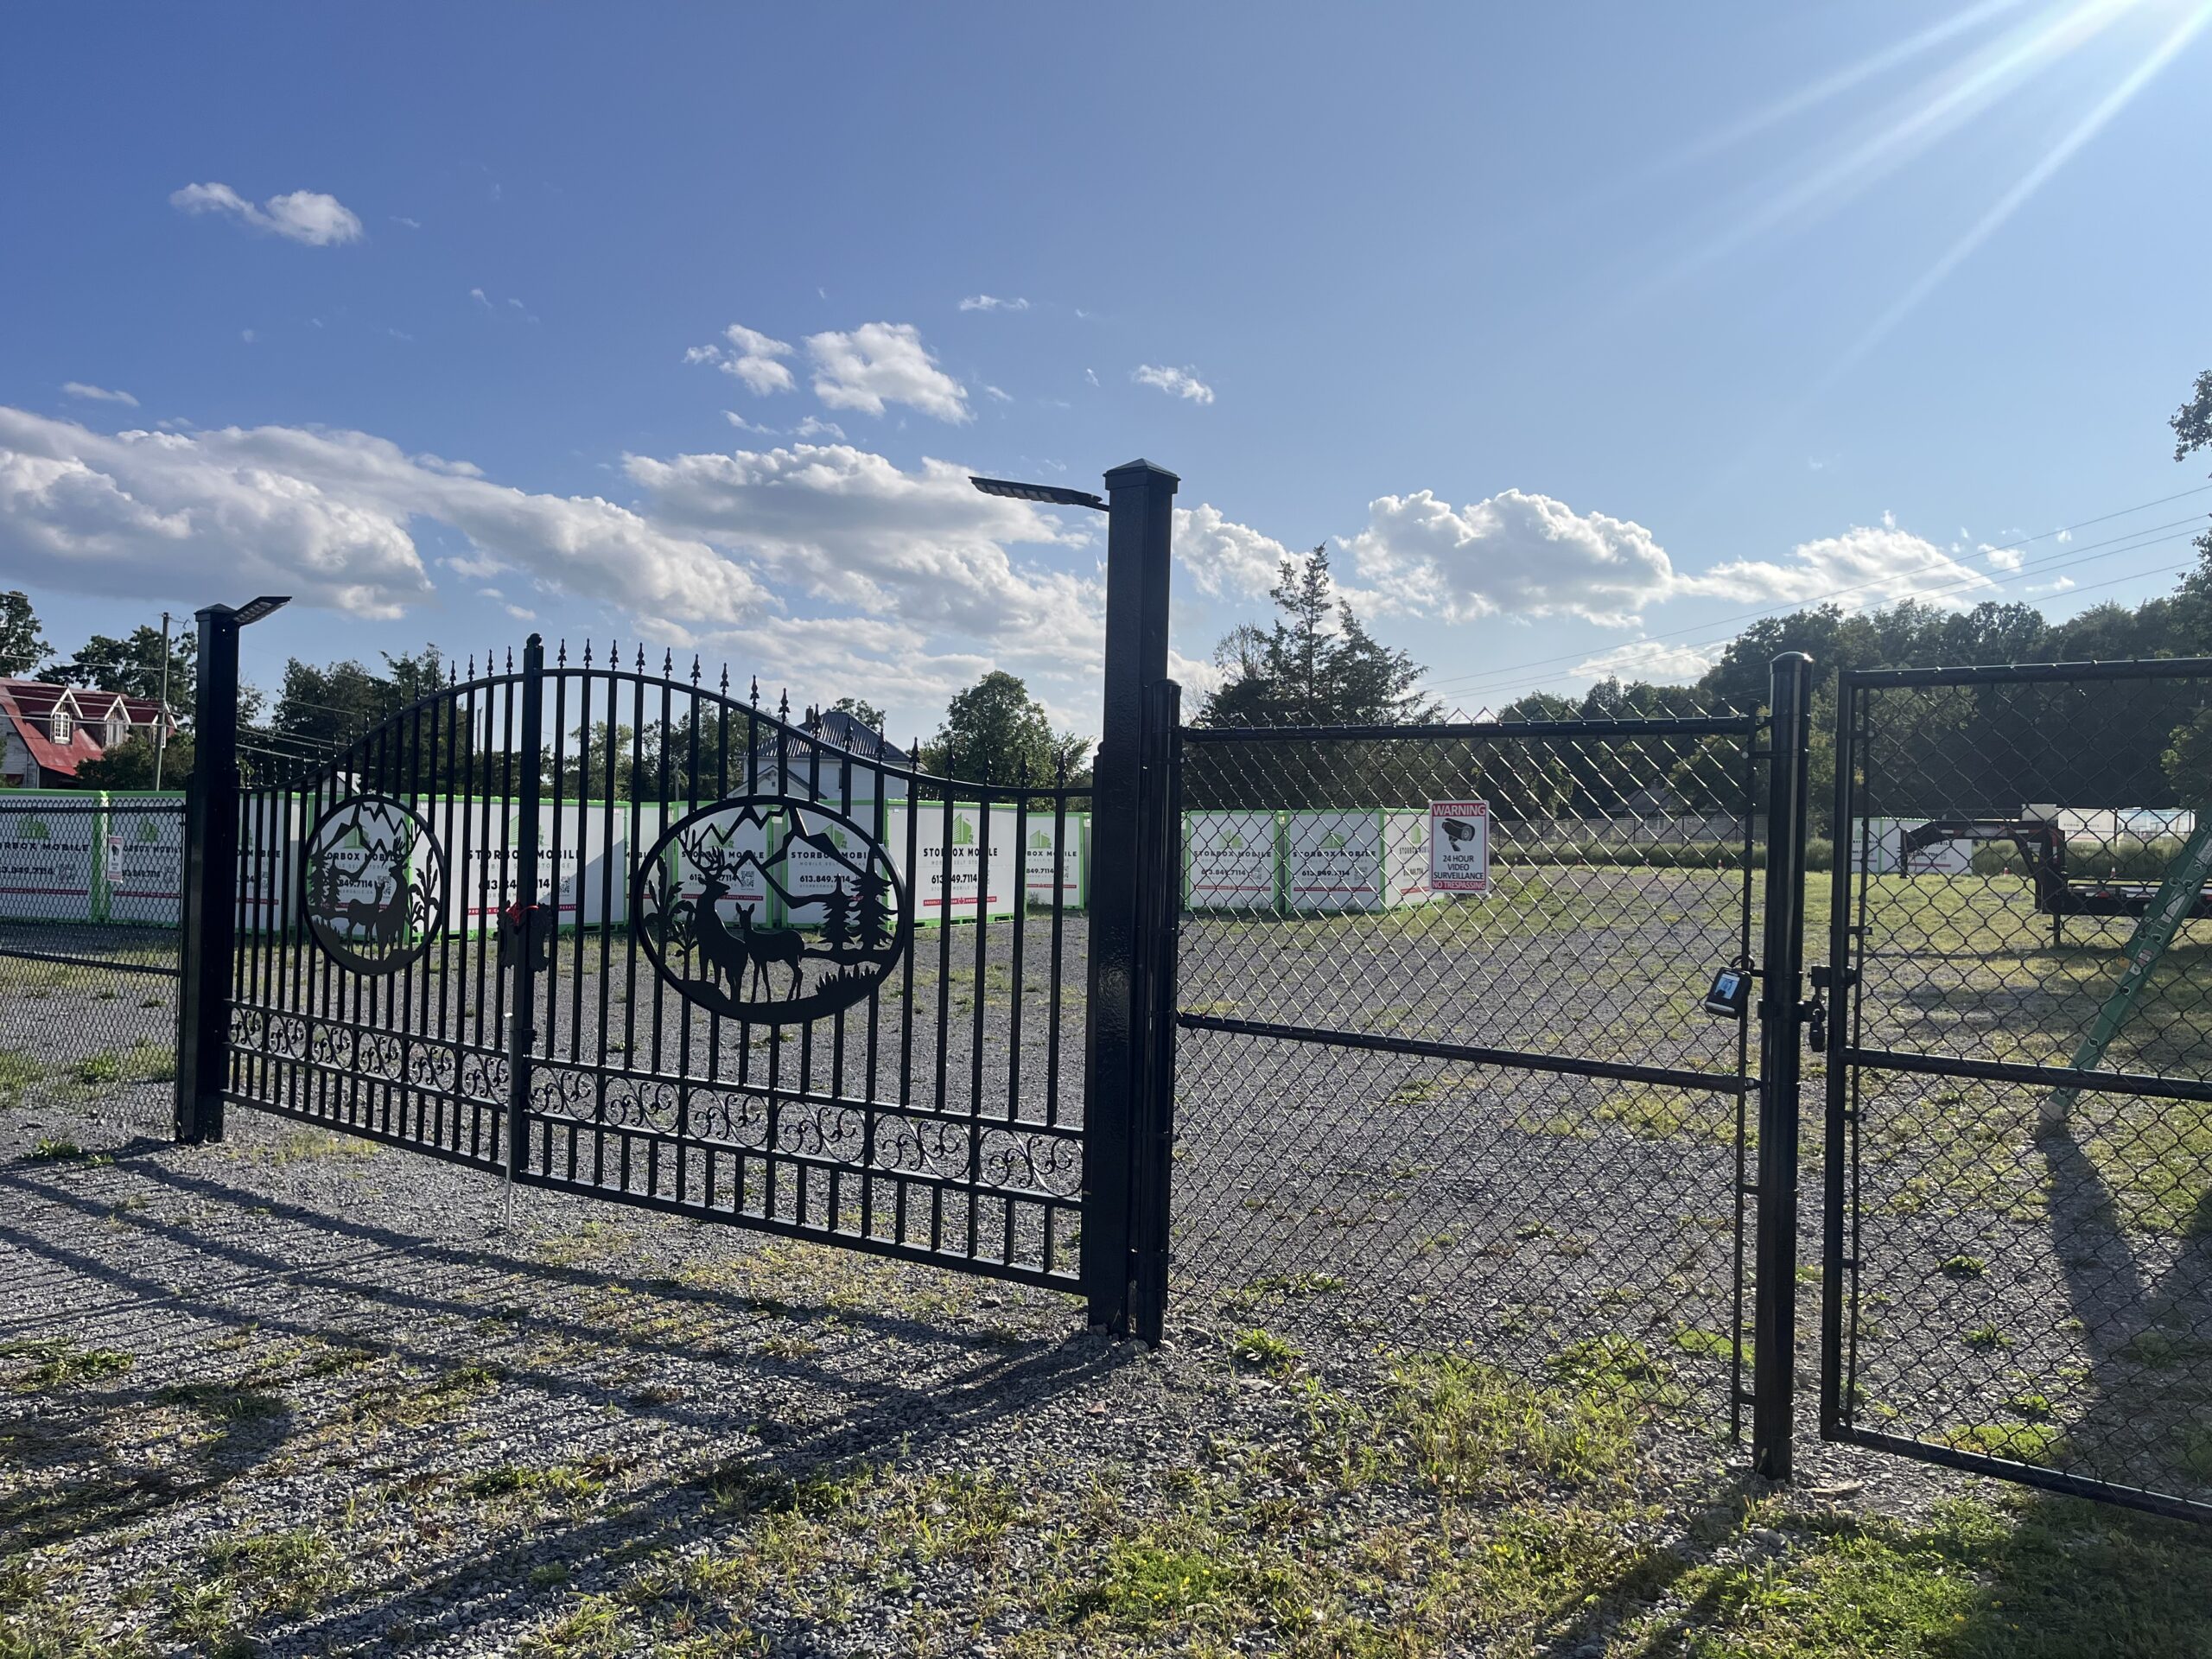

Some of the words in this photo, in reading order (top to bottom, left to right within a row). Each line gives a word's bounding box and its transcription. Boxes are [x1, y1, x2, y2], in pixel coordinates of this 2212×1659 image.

[1433, 804, 1485, 816] WARNING
[924, 848, 963, 857] STOOX
[968, 848, 998, 856] MOLE
[931, 874, 978, 884] 61349.7114
